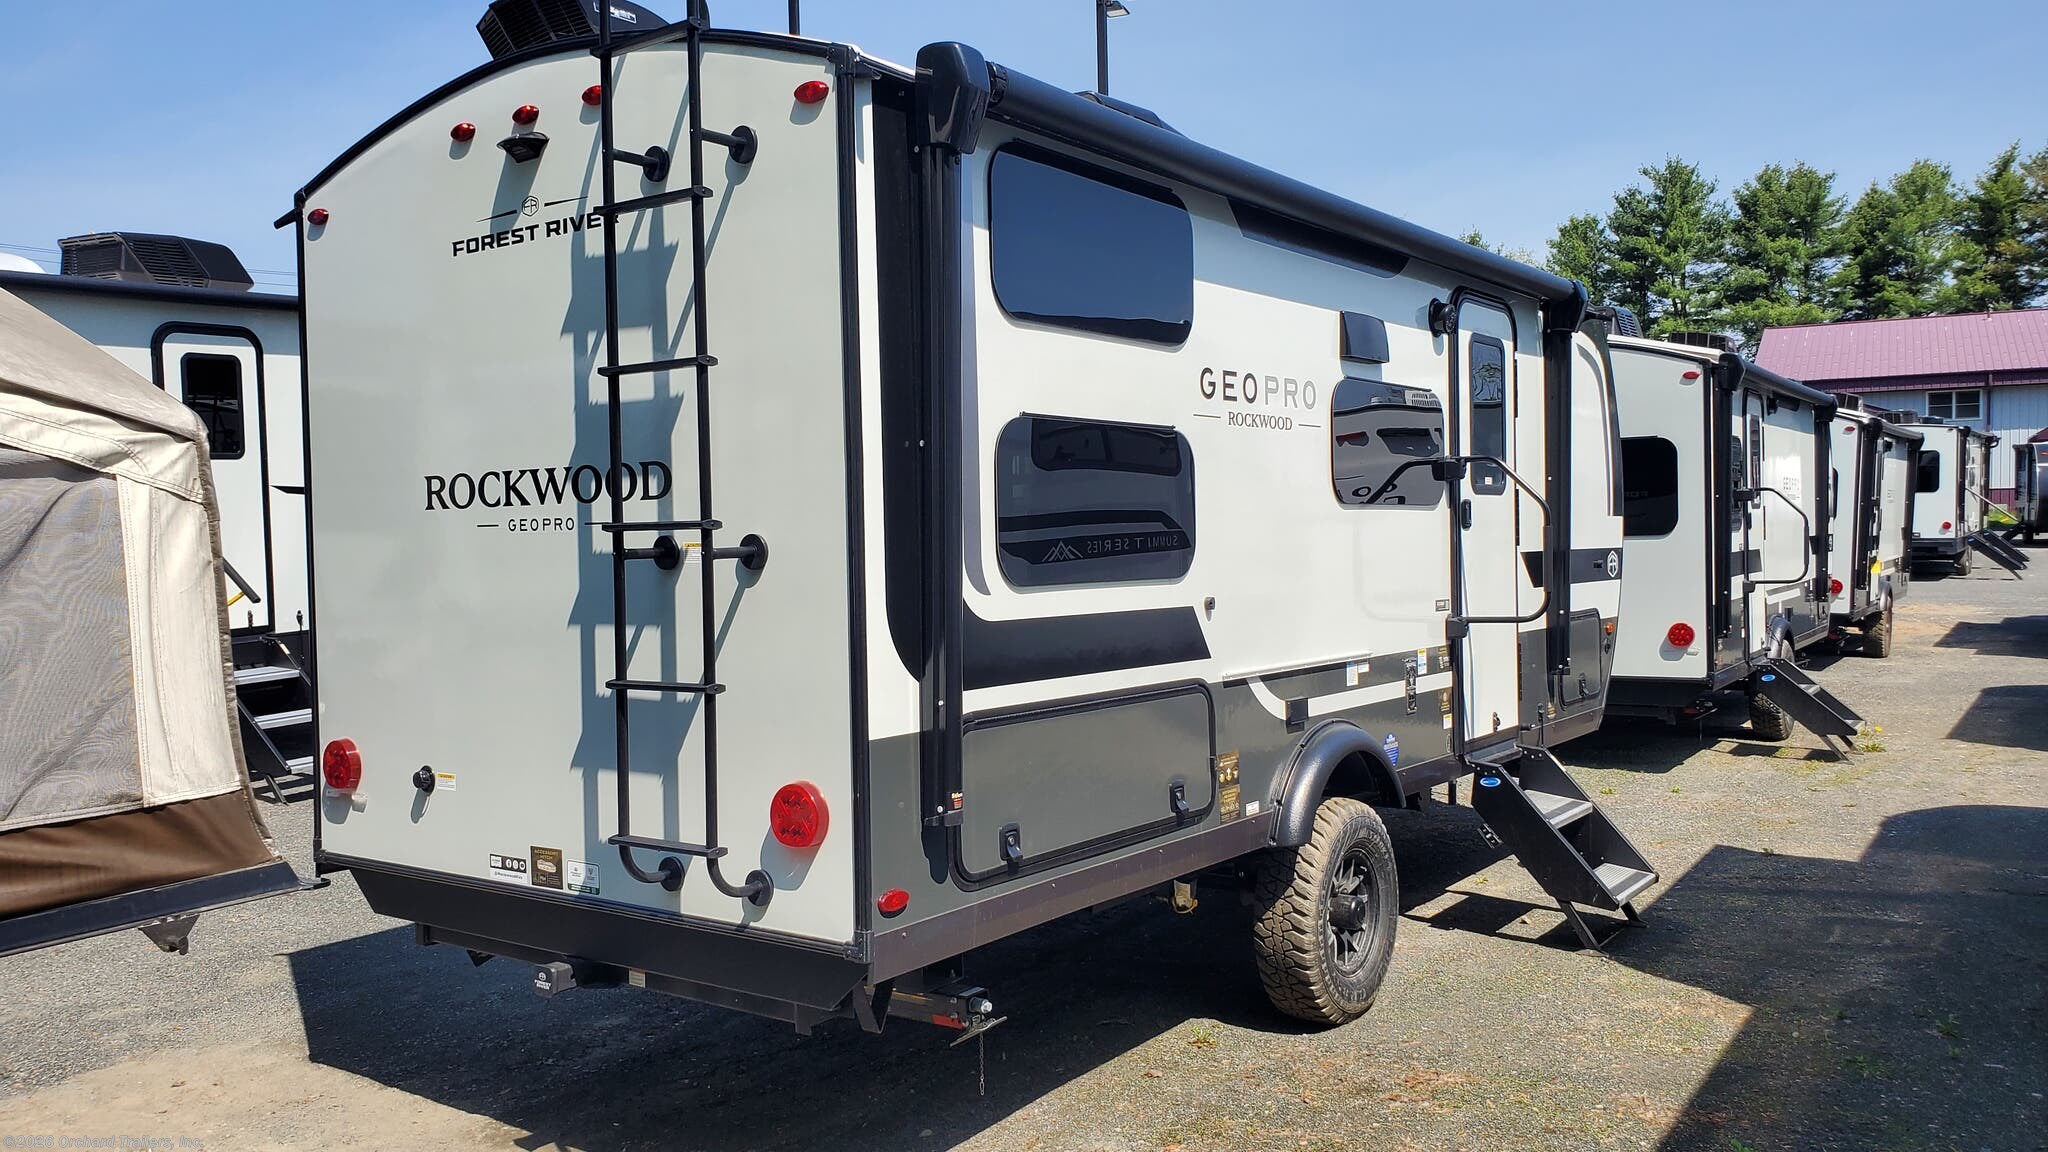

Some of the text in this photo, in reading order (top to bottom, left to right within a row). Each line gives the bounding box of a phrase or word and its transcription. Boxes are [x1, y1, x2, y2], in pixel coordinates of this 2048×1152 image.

[452, 211, 620, 256] FOREST RIVE
[1199, 367, 1317, 410] GEOPRO
[1228, 411, 1293, 431] ROCKWOOD
[424, 460, 673, 510] ROCKWOOD
[507, 517, 575, 531] GEOPRO
